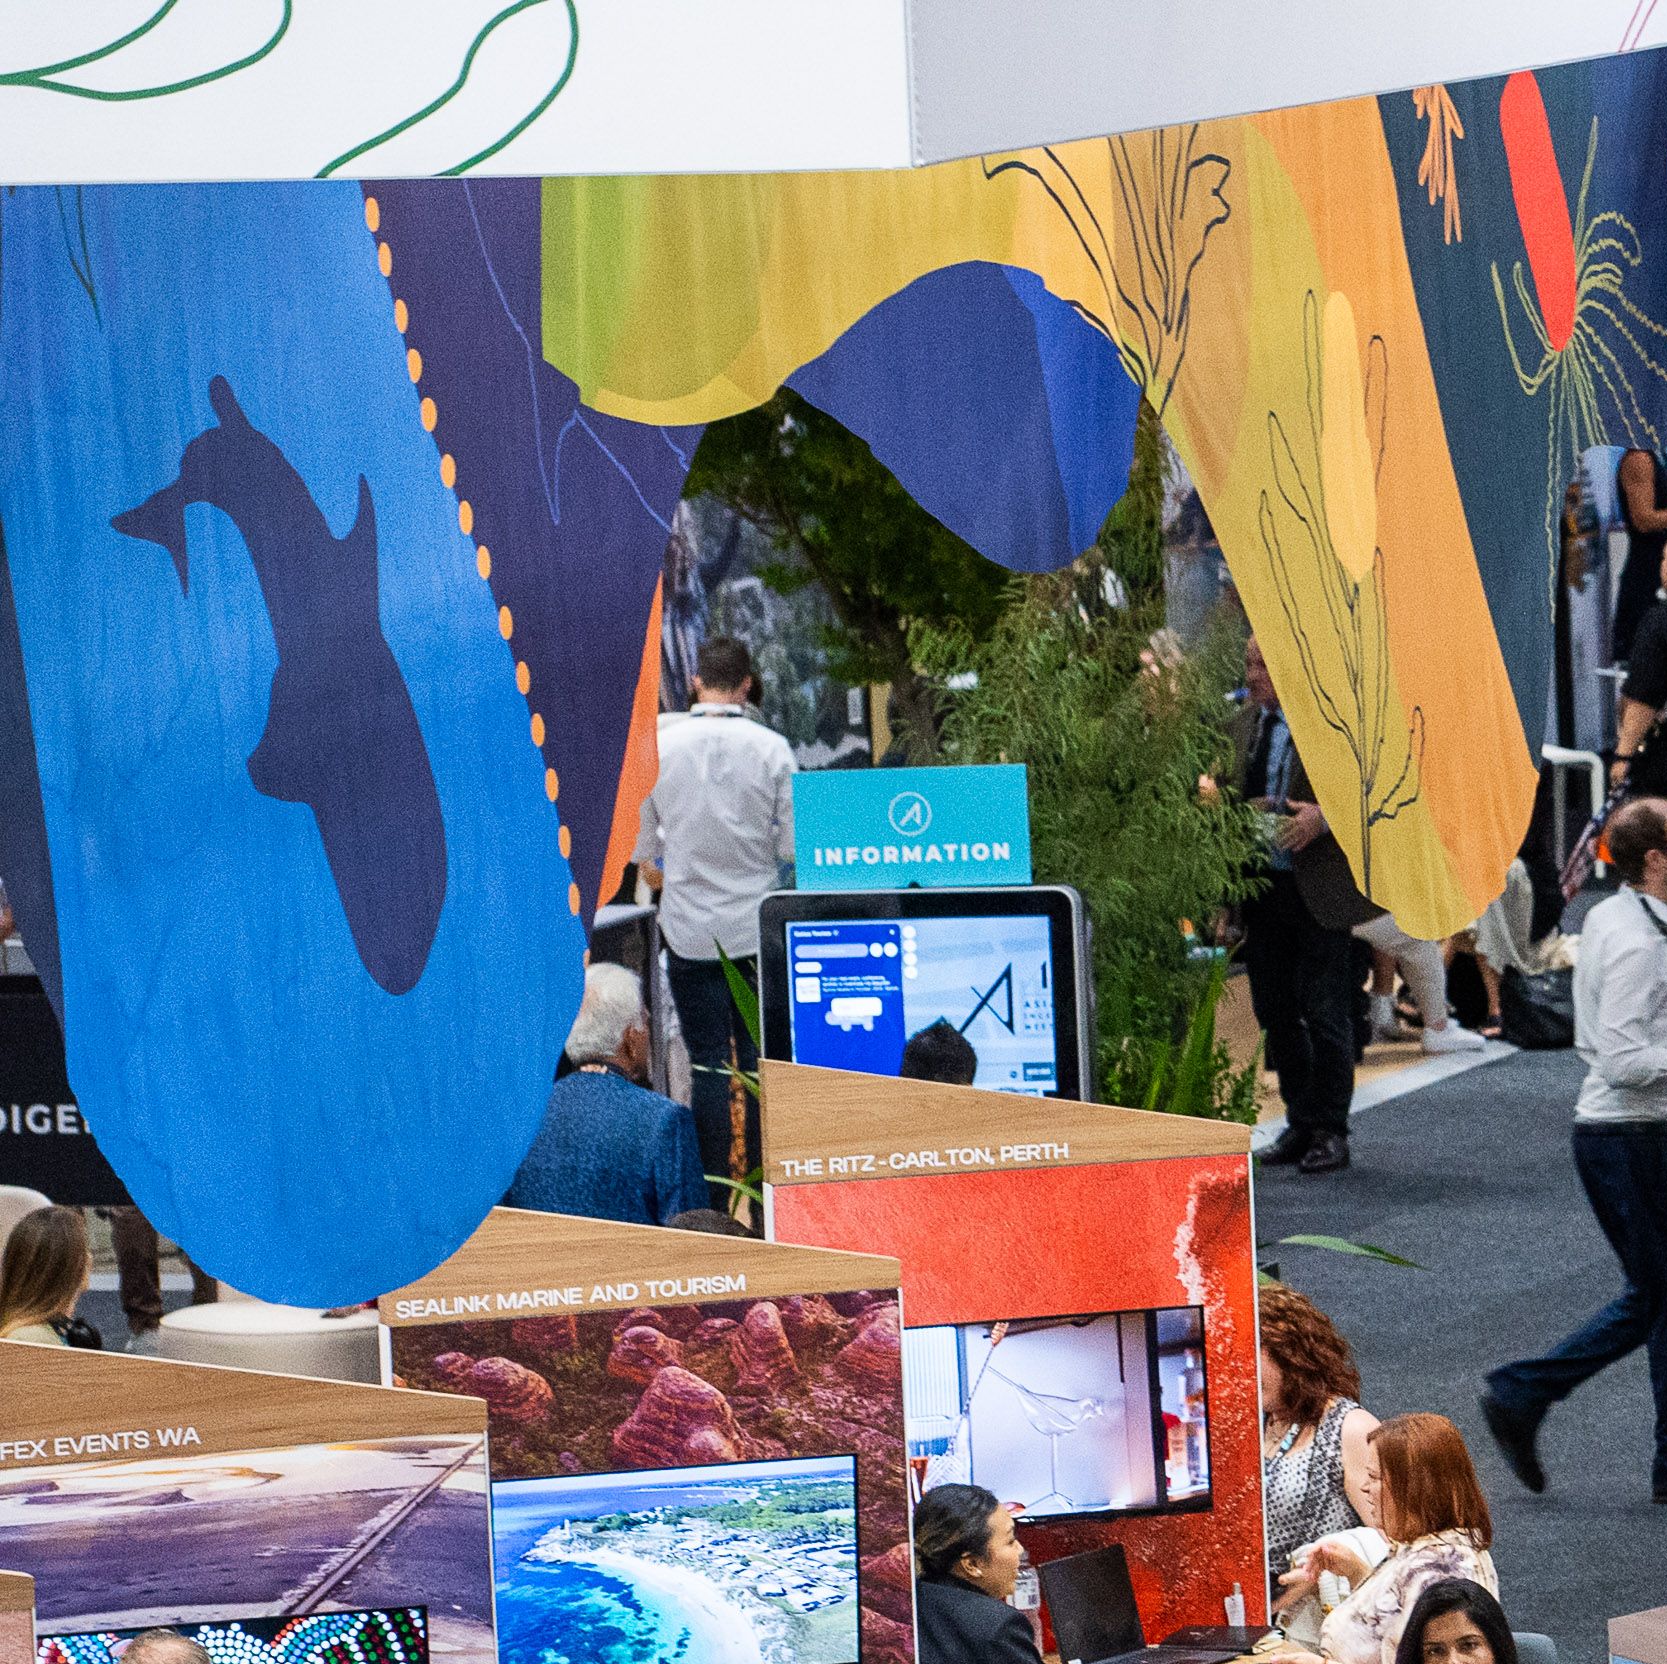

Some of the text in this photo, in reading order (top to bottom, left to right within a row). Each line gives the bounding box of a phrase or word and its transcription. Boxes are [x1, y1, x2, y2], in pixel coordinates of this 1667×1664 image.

[814, 843, 1010, 866] INFORMATION
[0, 1103, 92, 1134] IGE
[780, 1157, 824, 1177] THE
[1000, 1142, 1069, 1163] PERTH
[395, 1273, 746, 1320] SEALINK MARINE AND TOURISM
[0, 1426, 202, 1461] FEX EVENTS WA
